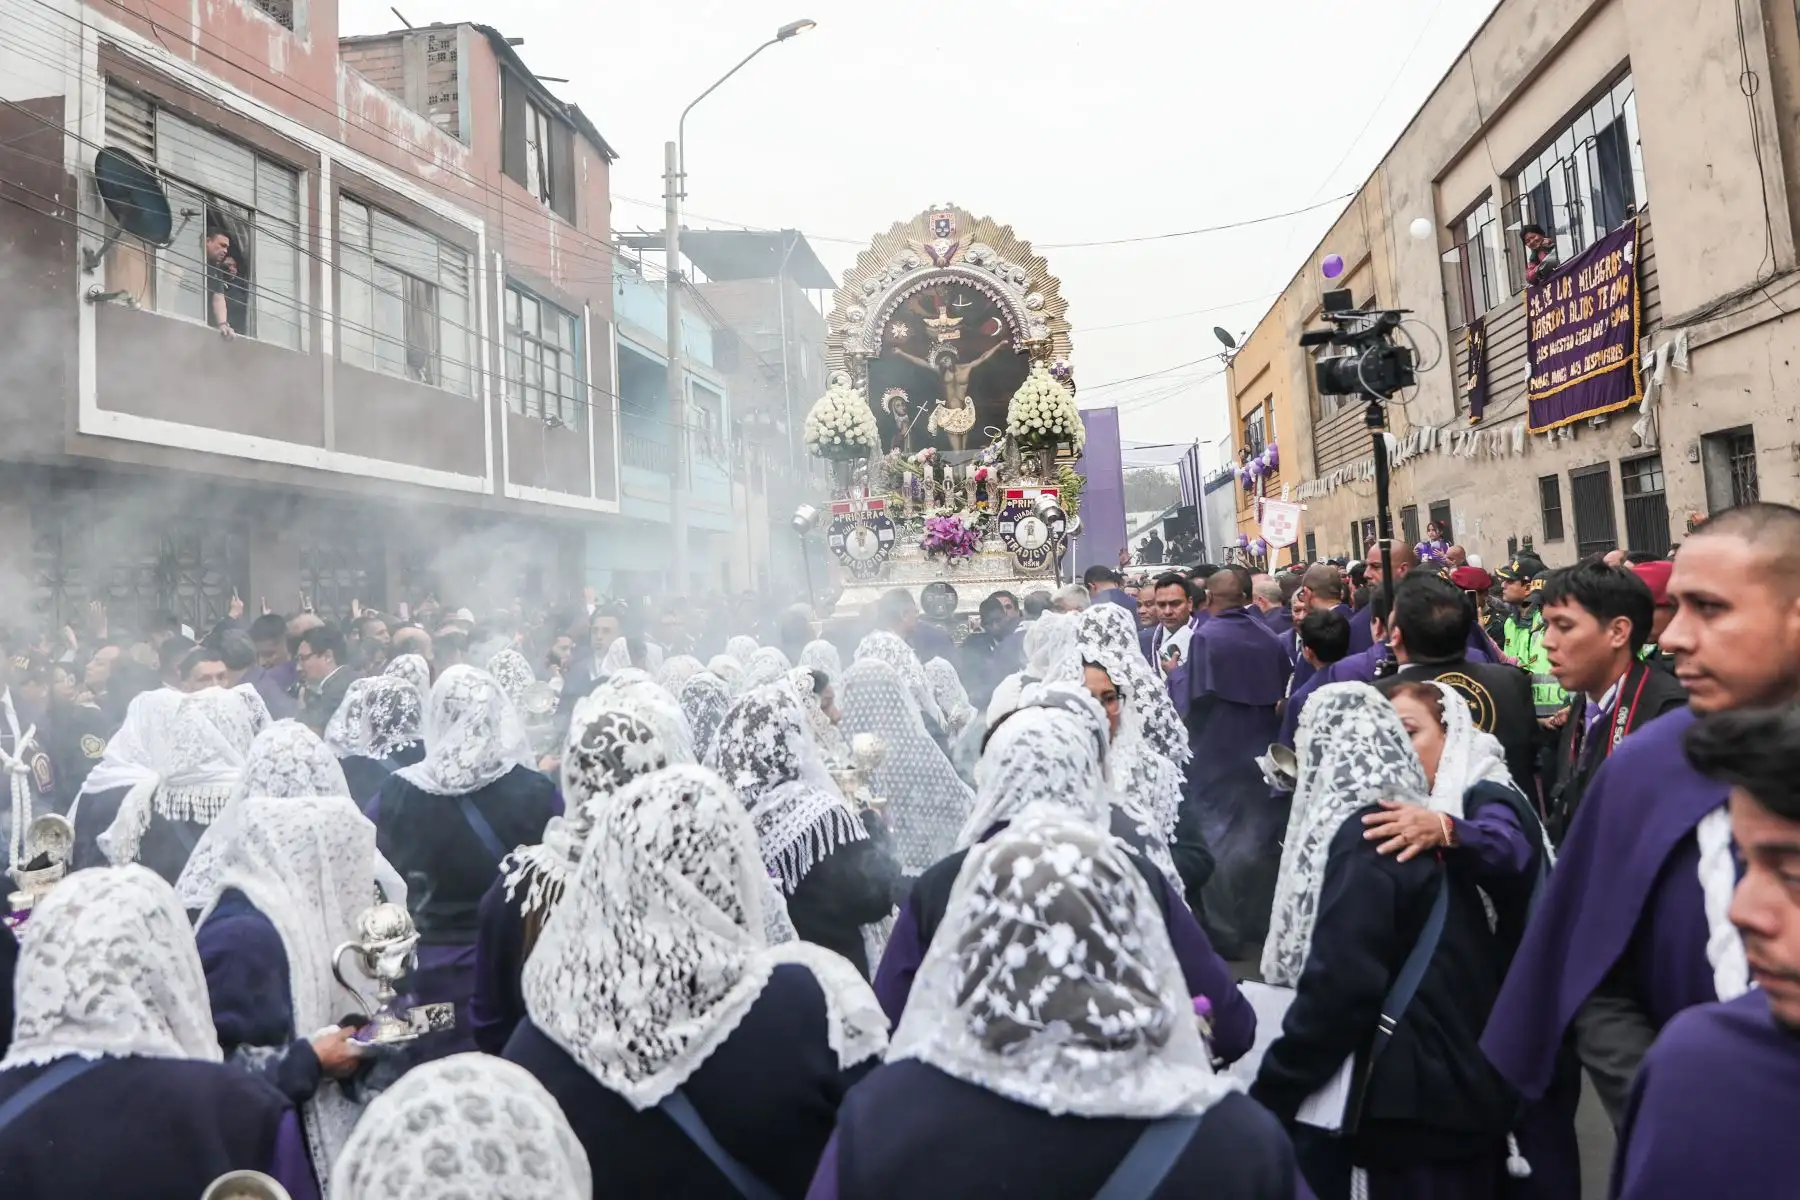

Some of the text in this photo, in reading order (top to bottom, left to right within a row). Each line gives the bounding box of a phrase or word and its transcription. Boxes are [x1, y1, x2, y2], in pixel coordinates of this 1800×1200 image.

[1556, 275, 1573, 301] LOS
[1579, 249, 1622, 294] MILAGROS
[1569, 295, 1594, 324] ALTOS
[1597, 284, 1609, 311] TE
[1609, 274, 1629, 308] AMO
[1011, 499, 1034, 508] PRIM
[840, 547, 893, 570] TRADICION
